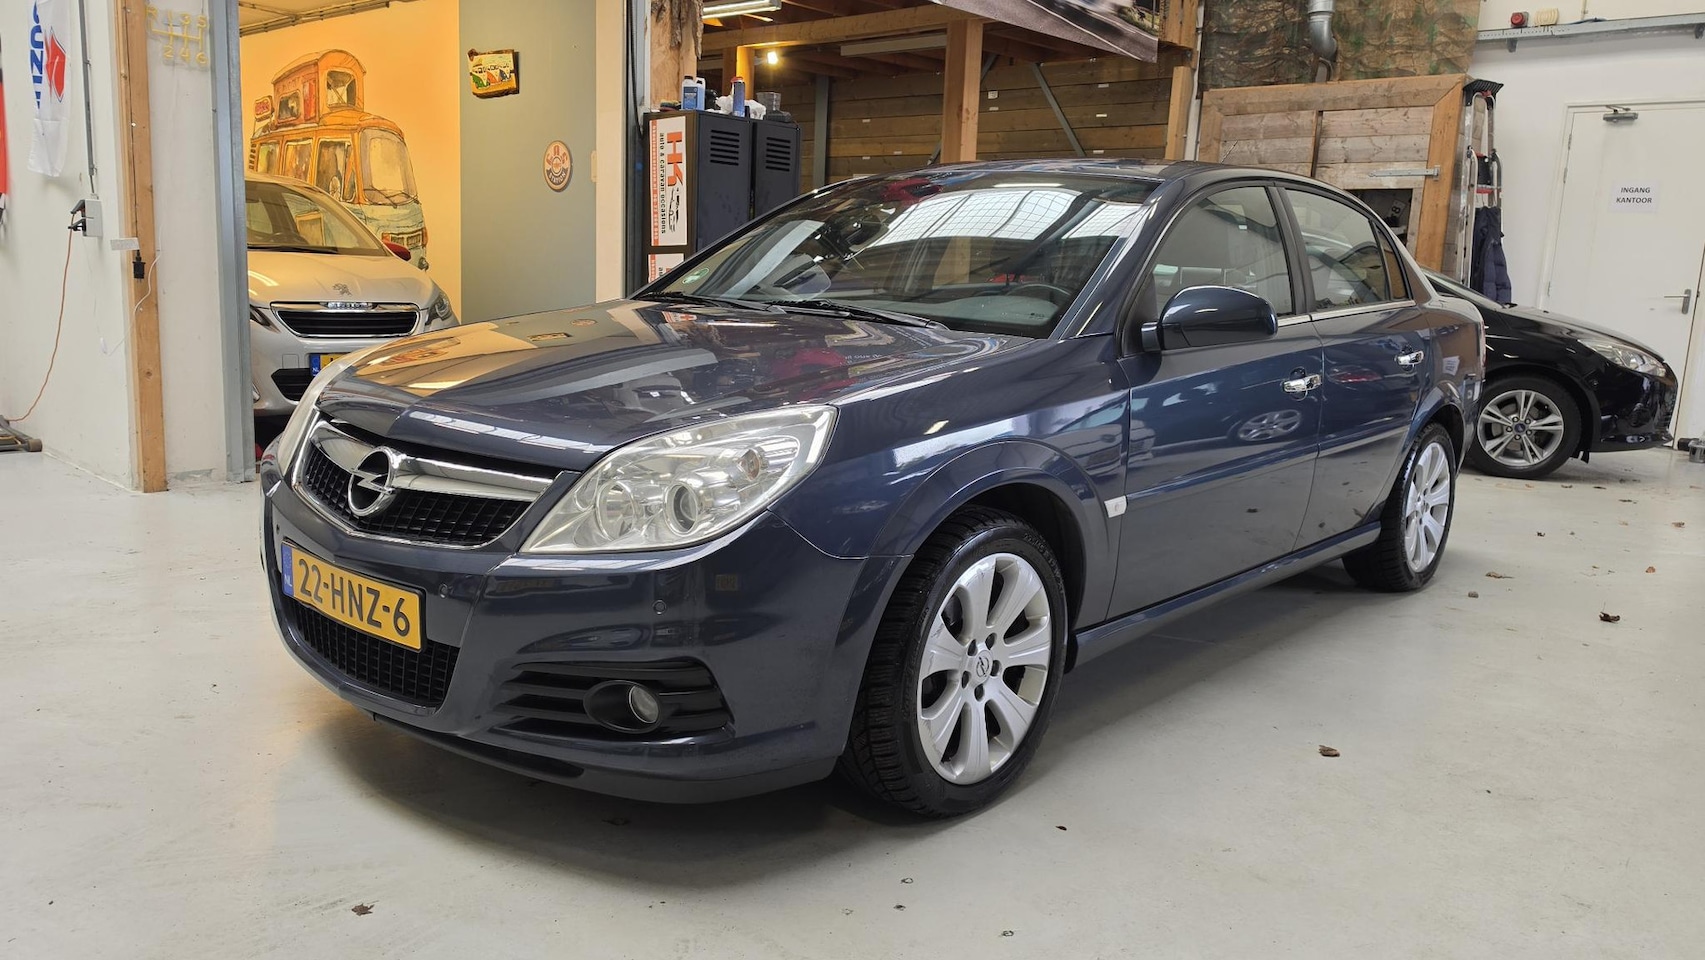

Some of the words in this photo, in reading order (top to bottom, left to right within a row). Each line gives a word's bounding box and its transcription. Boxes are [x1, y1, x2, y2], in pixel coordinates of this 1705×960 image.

[667, 131, 683, 186] HK
[284, 573, 292, 587] NL
[299, 558, 410, 637] 22-HNZ-6
